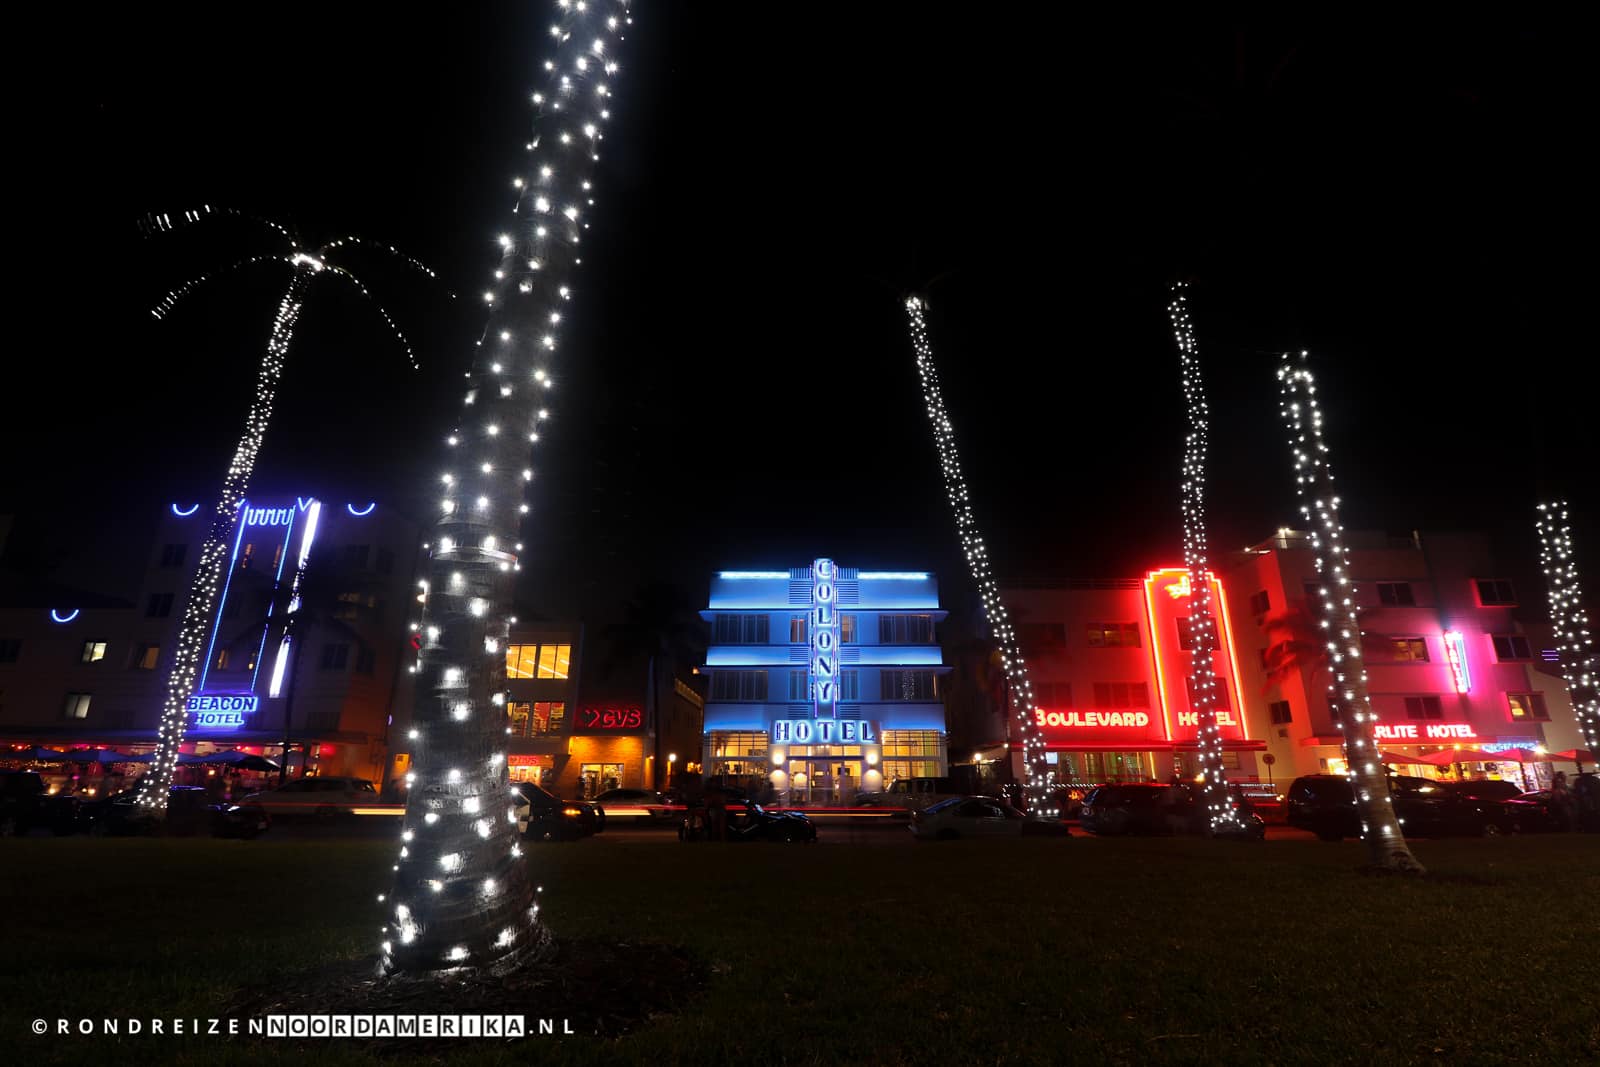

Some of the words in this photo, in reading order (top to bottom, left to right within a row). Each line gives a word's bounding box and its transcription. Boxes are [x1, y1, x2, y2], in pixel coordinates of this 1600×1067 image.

[817, 559, 833, 701] COLONY
[188, 696, 256, 711] BEACON
[195, 712, 244, 724] HOTEL
[602, 707, 641, 729] CVS
[1036, 708, 1149, 727] BOULEVARD
[1177, 711, 1238, 727] HOEL
[775, 720, 875, 741] HOTEL
[1426, 723, 1477, 739] HOTEL
